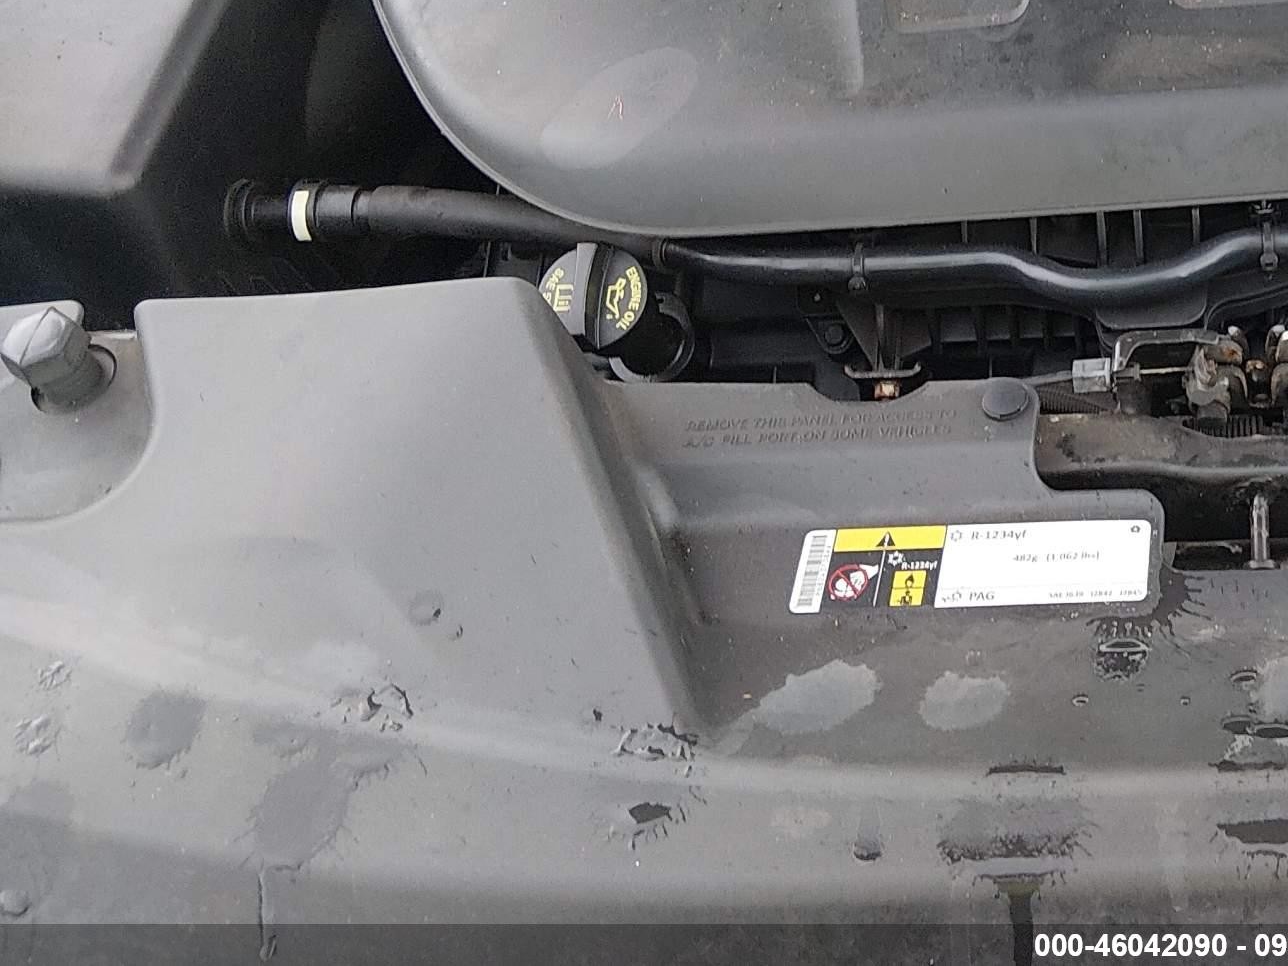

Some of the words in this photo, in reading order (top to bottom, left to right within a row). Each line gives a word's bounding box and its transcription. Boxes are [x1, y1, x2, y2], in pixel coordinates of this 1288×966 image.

[625, 266, 642, 311] ENGINE
[615, 310, 635, 331] OIL
[684, 418, 748, 432] REMOVE
[970, 529, 1028, 541] R-1234yf
[968, 590, 996, 601] PAG
